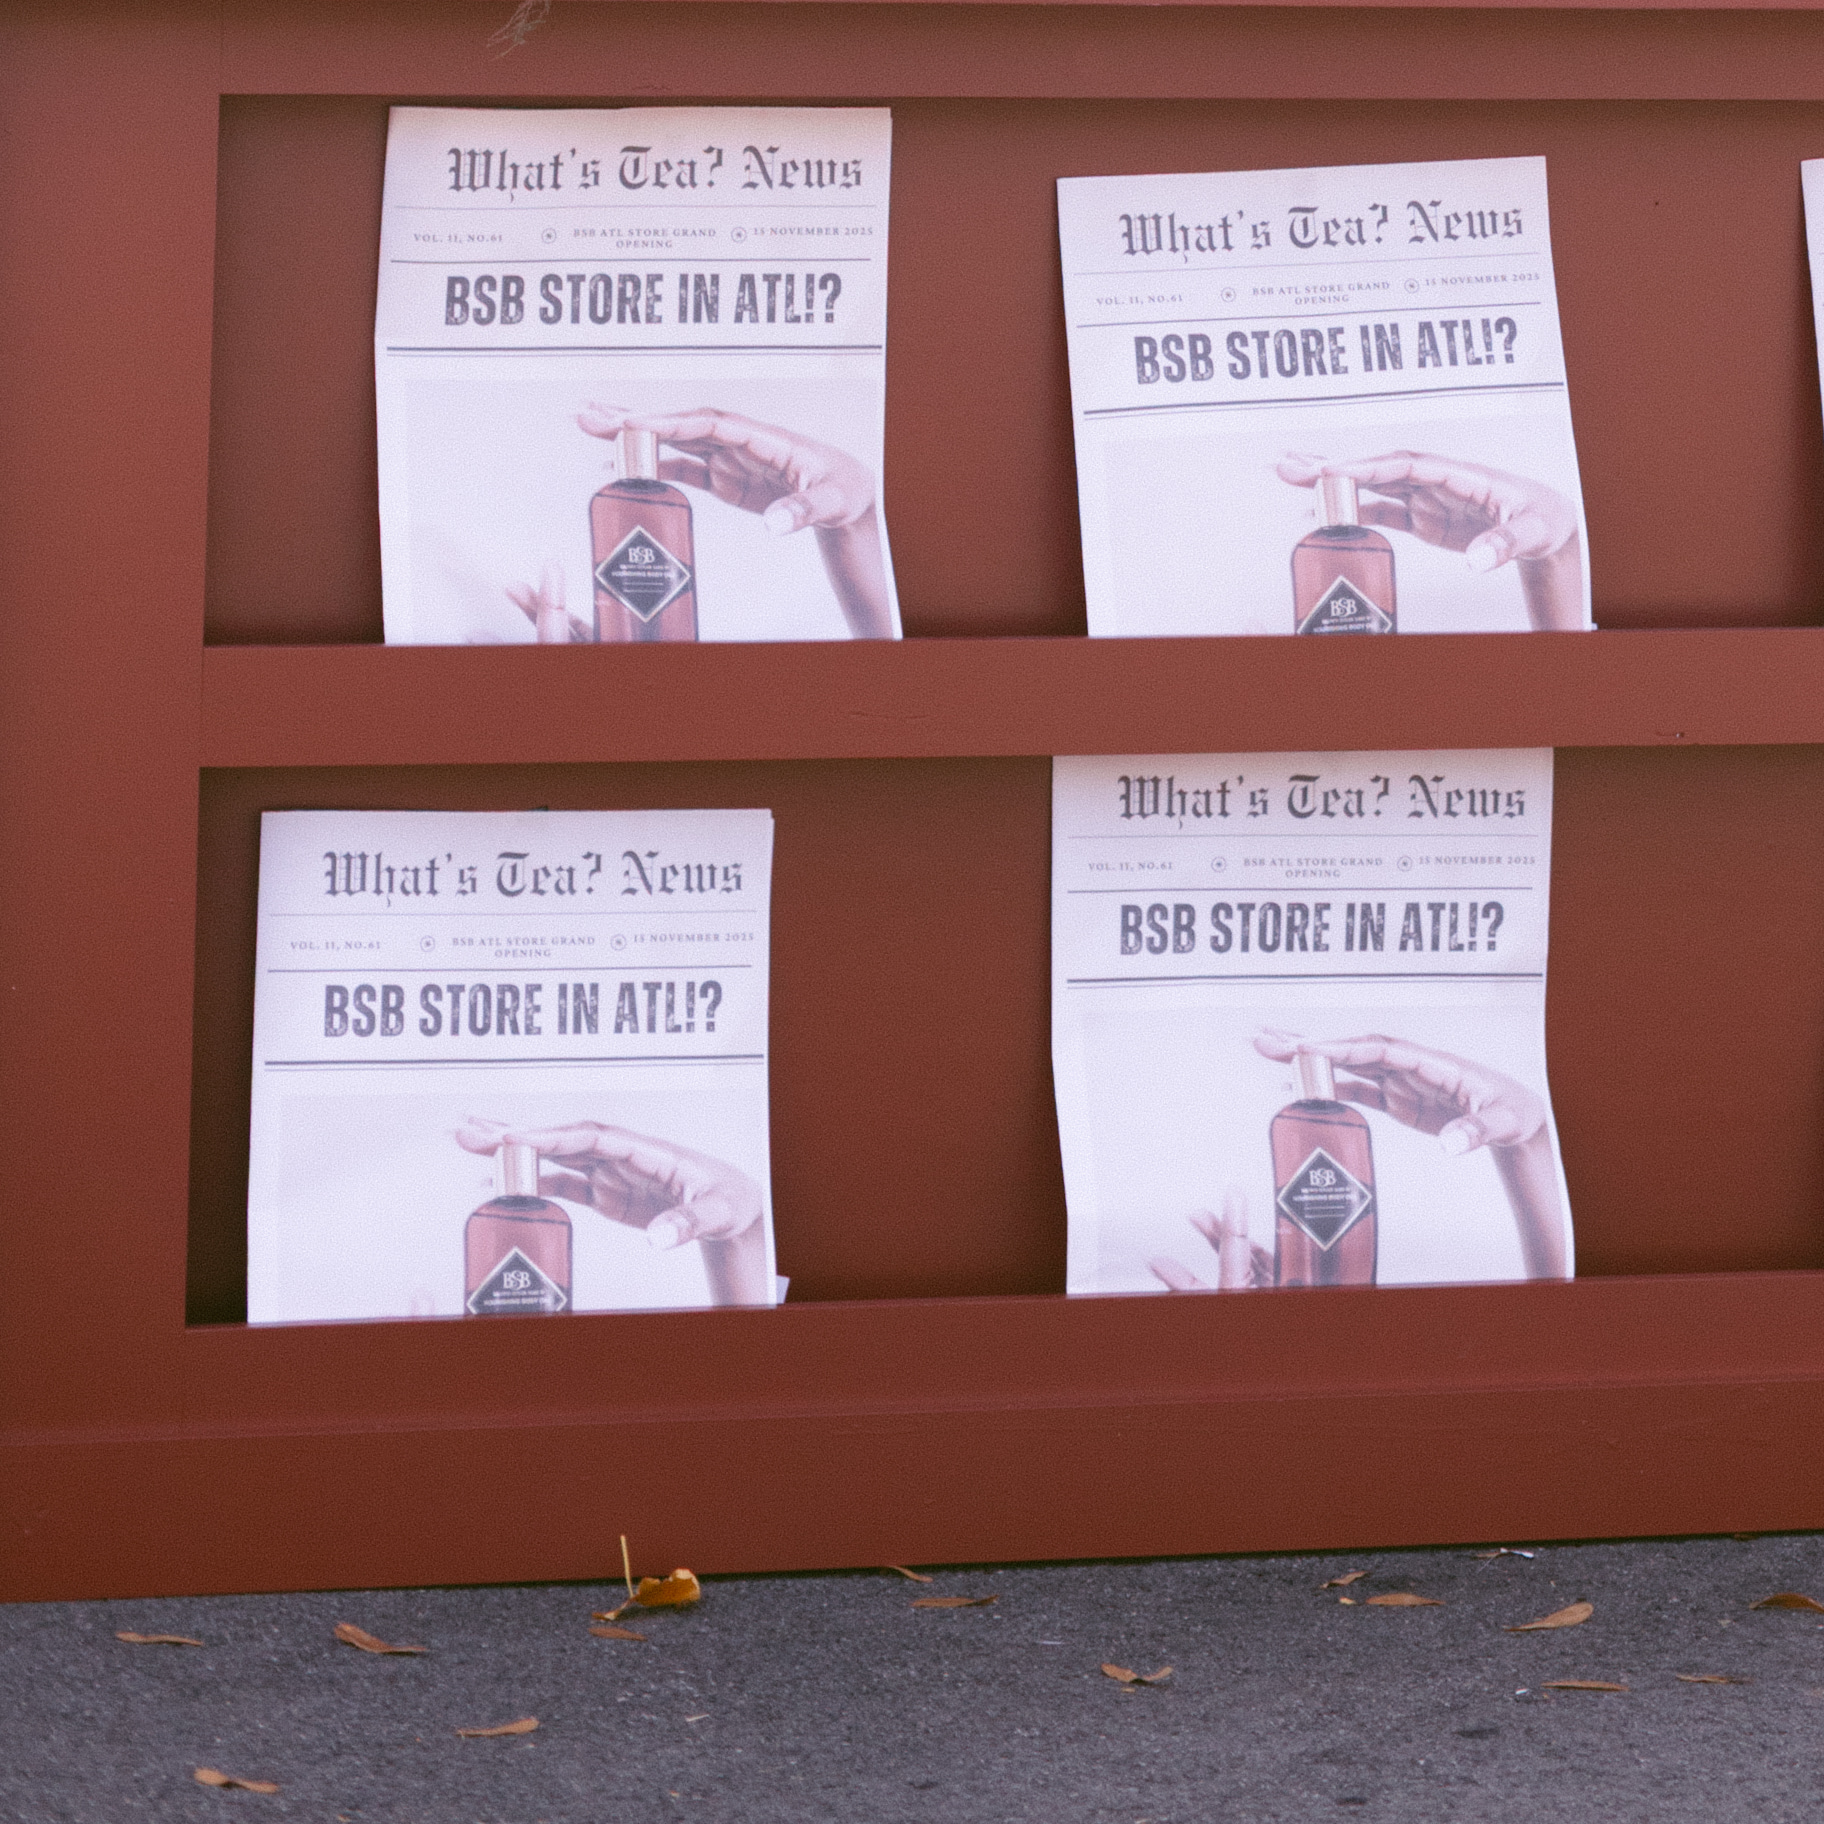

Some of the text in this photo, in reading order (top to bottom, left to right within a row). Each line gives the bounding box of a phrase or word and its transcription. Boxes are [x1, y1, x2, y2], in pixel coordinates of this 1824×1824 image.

[448, 145, 862, 202] What's Tea? News
[616, 240, 673, 249] OPENING
[627, 229, 669, 237] STORE
[672, 229, 716, 237] GRAND
[770, 228, 840, 236] NOVEMBER
[844, 227, 873, 236] 2025
[1120, 200, 1523, 265] What's Tea? News
[445, 272, 842, 325] BSB STORE IN ATL!?
[1135, 316, 1517, 385] BSB STORE IN ATL!?
[1118, 774, 1525, 829] What's Tea? News
[323, 851, 742, 908] What's Tea? News
[1121, 900, 1504, 955] BSB STORE IN ATL!?
[324, 980, 723, 1037] BSB STORE IN ATL!?
